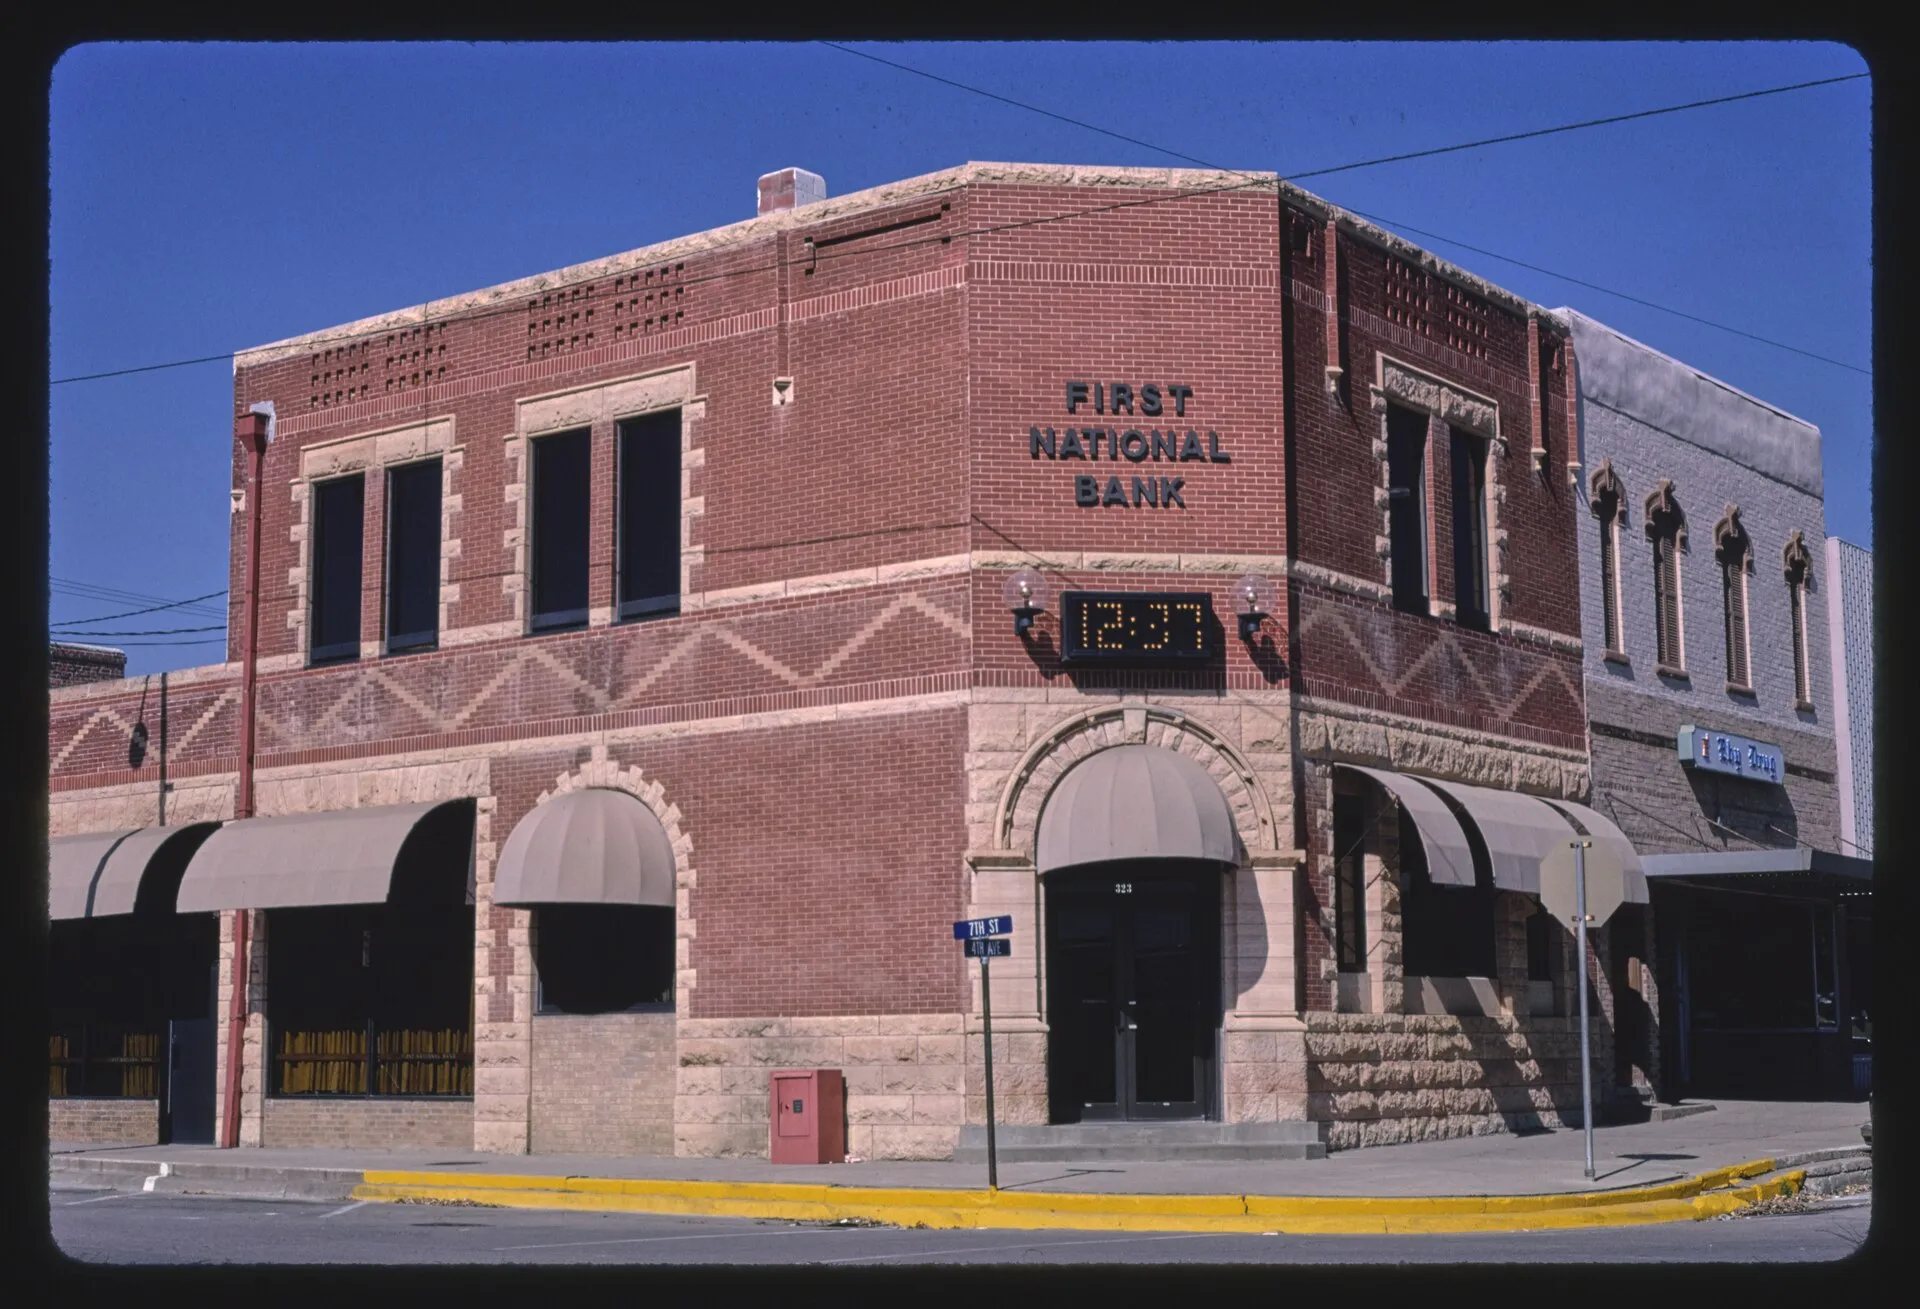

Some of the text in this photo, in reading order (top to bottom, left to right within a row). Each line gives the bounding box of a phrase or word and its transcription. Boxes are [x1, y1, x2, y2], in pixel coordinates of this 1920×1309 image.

[1066, 381, 1193, 417] FIRST
[1030, 426, 1232, 463] NATIONAL
[1075, 475, 1187, 509] BANK
[1082, 602, 1202, 649] 12:37
[1747, 744, 1776, 780] Drug
[1115, 883, 1132, 893] 323
[968, 918, 999, 937] 7TH ST
[971, 940, 1002, 956] 4TH AVE
